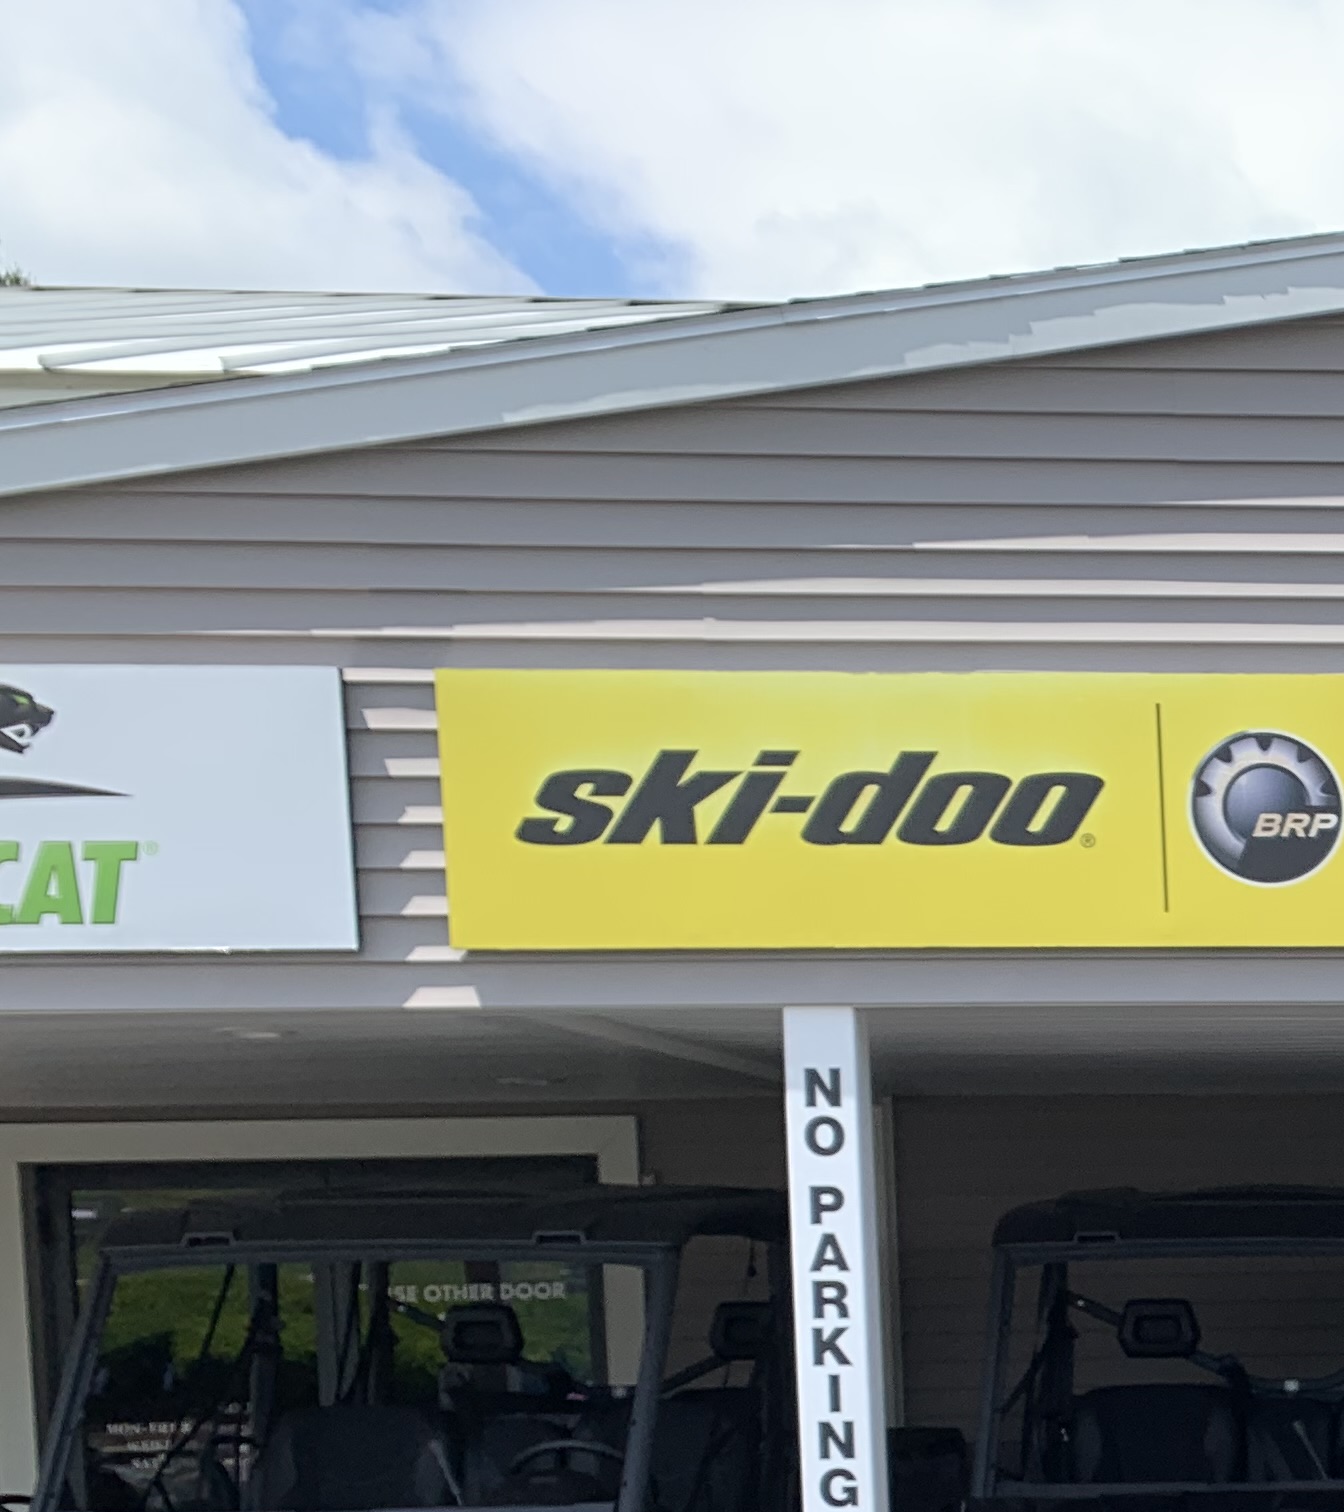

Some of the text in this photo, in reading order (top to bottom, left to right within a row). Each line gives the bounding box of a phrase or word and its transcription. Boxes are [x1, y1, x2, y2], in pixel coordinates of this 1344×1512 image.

[514, 749, 1105, 846] ski-doo
[1251, 811, 1339, 838] BRP
[423, 1283, 495, 1303] OTHER
[500, 1281, 566, 1300] DOOR
[804, 1067, 859, 1507] NO PARKING
